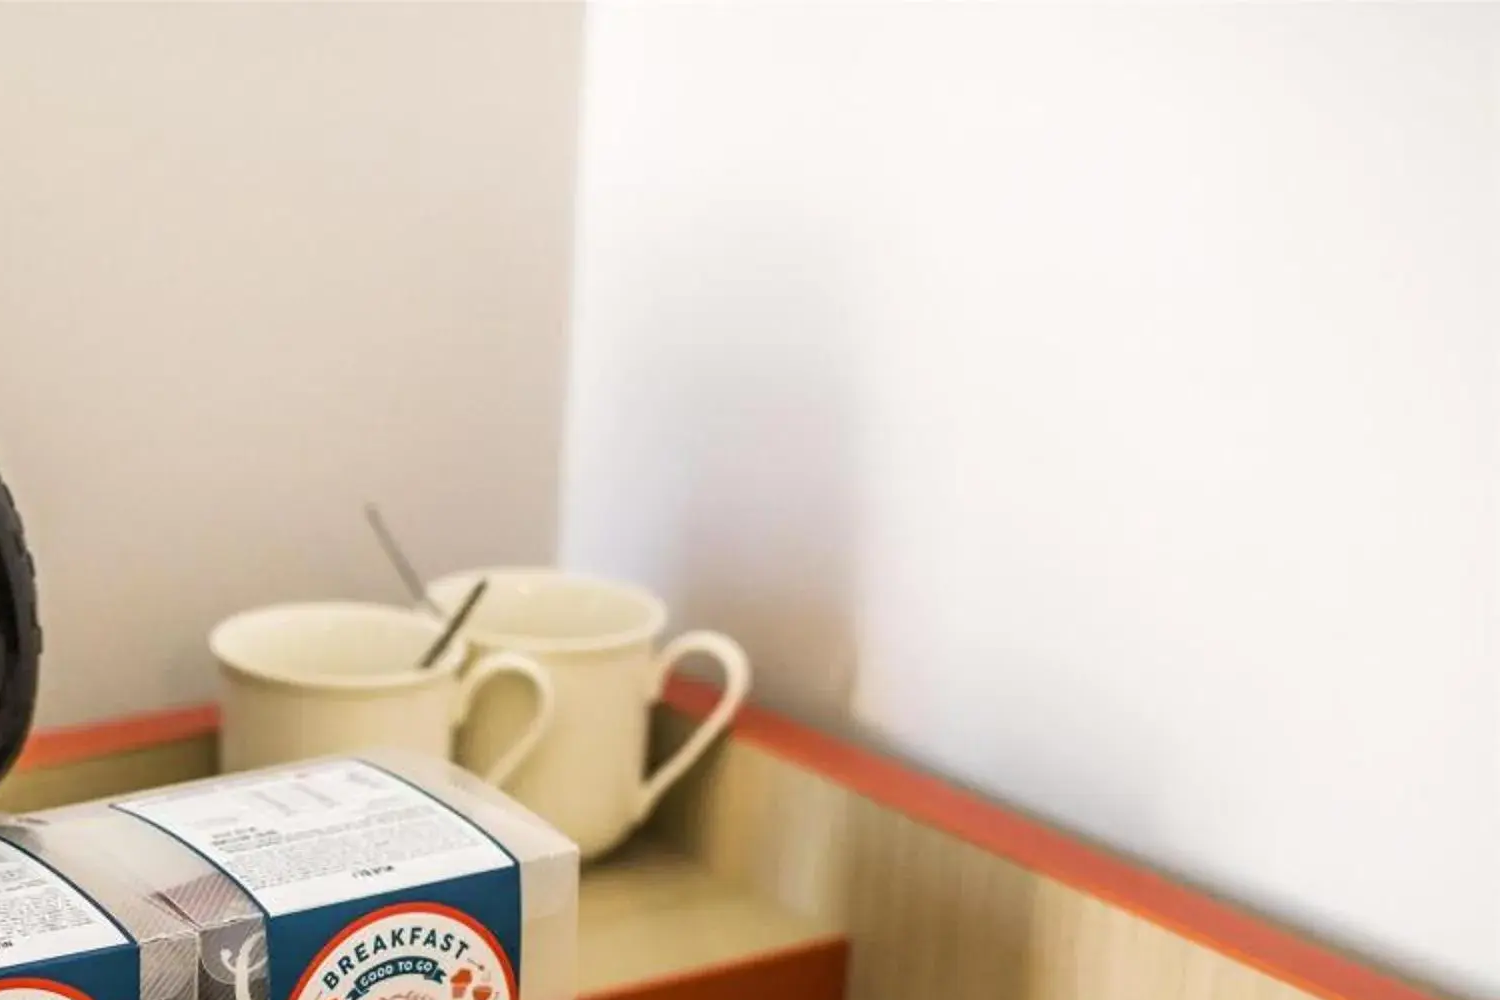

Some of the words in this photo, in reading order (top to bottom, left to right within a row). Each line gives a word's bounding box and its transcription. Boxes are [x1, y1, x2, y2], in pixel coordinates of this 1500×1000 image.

[323, 927, 470, 990] BREAKFAST
[359, 965, 394, 988] GOOD
[398, 961, 413, 972] TO
[415, 961, 434, 973] GO
